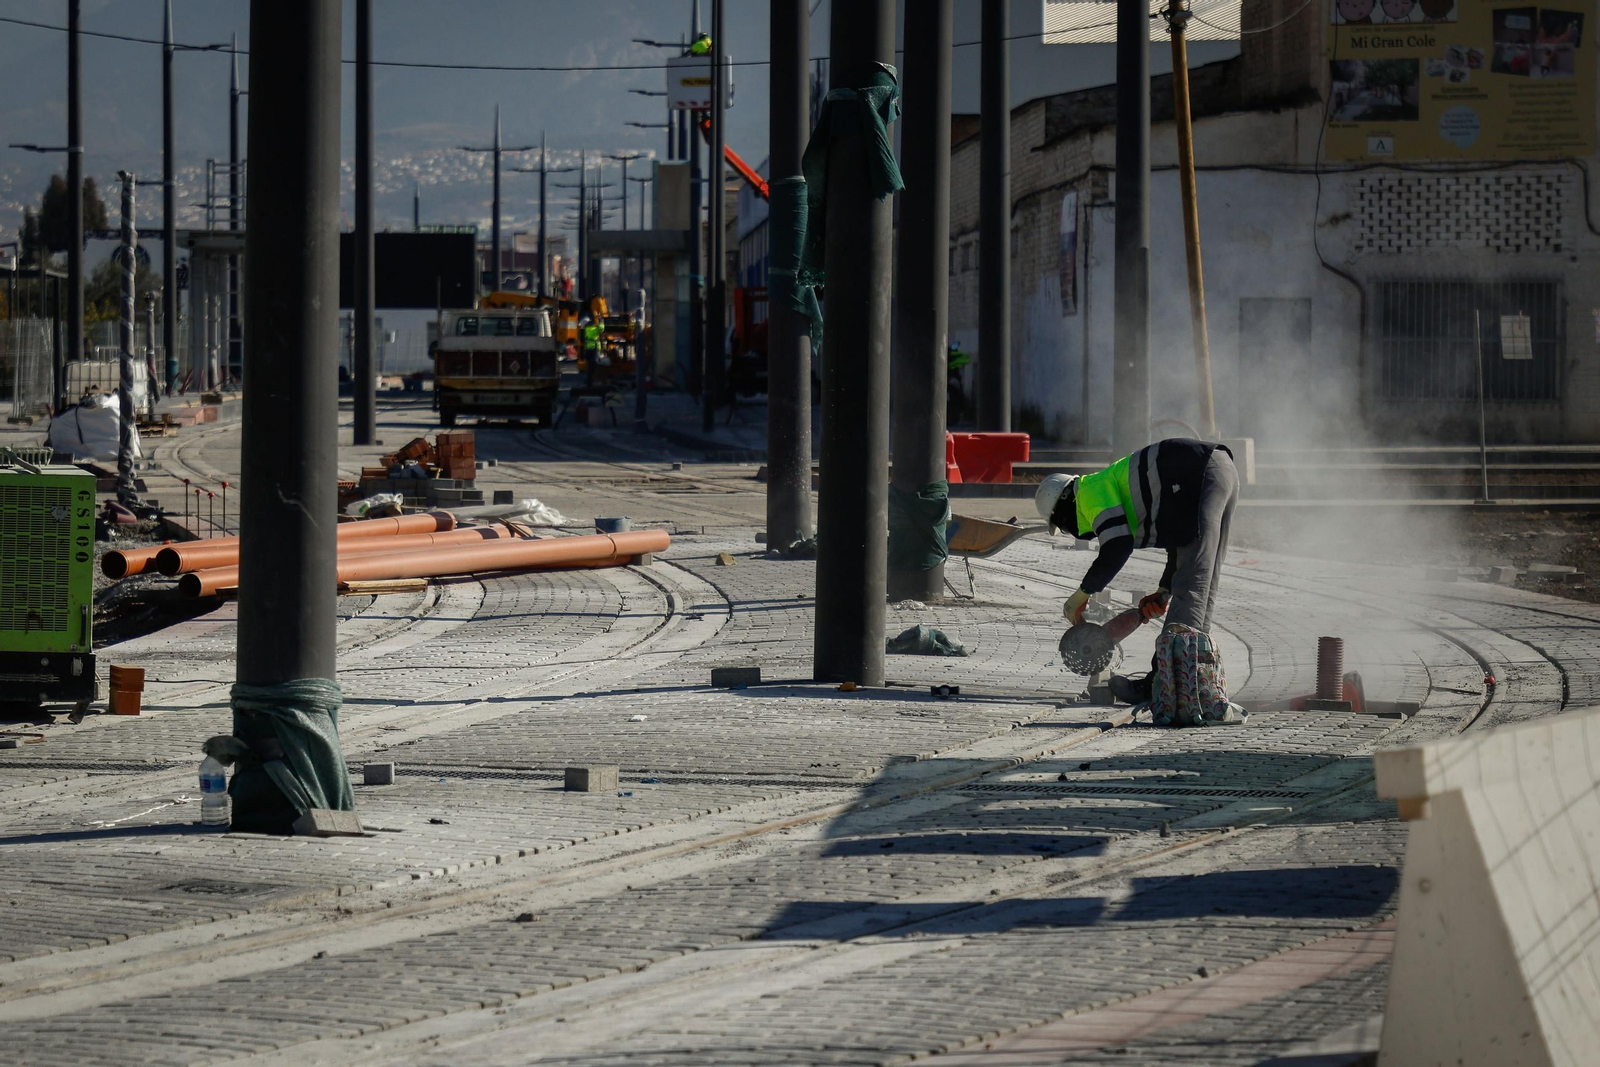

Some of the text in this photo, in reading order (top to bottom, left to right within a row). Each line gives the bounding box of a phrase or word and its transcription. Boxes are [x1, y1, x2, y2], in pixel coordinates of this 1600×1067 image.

[1351, 34, 1436, 49] Mi Gran Cole
[75, 489, 91, 563] GS100
